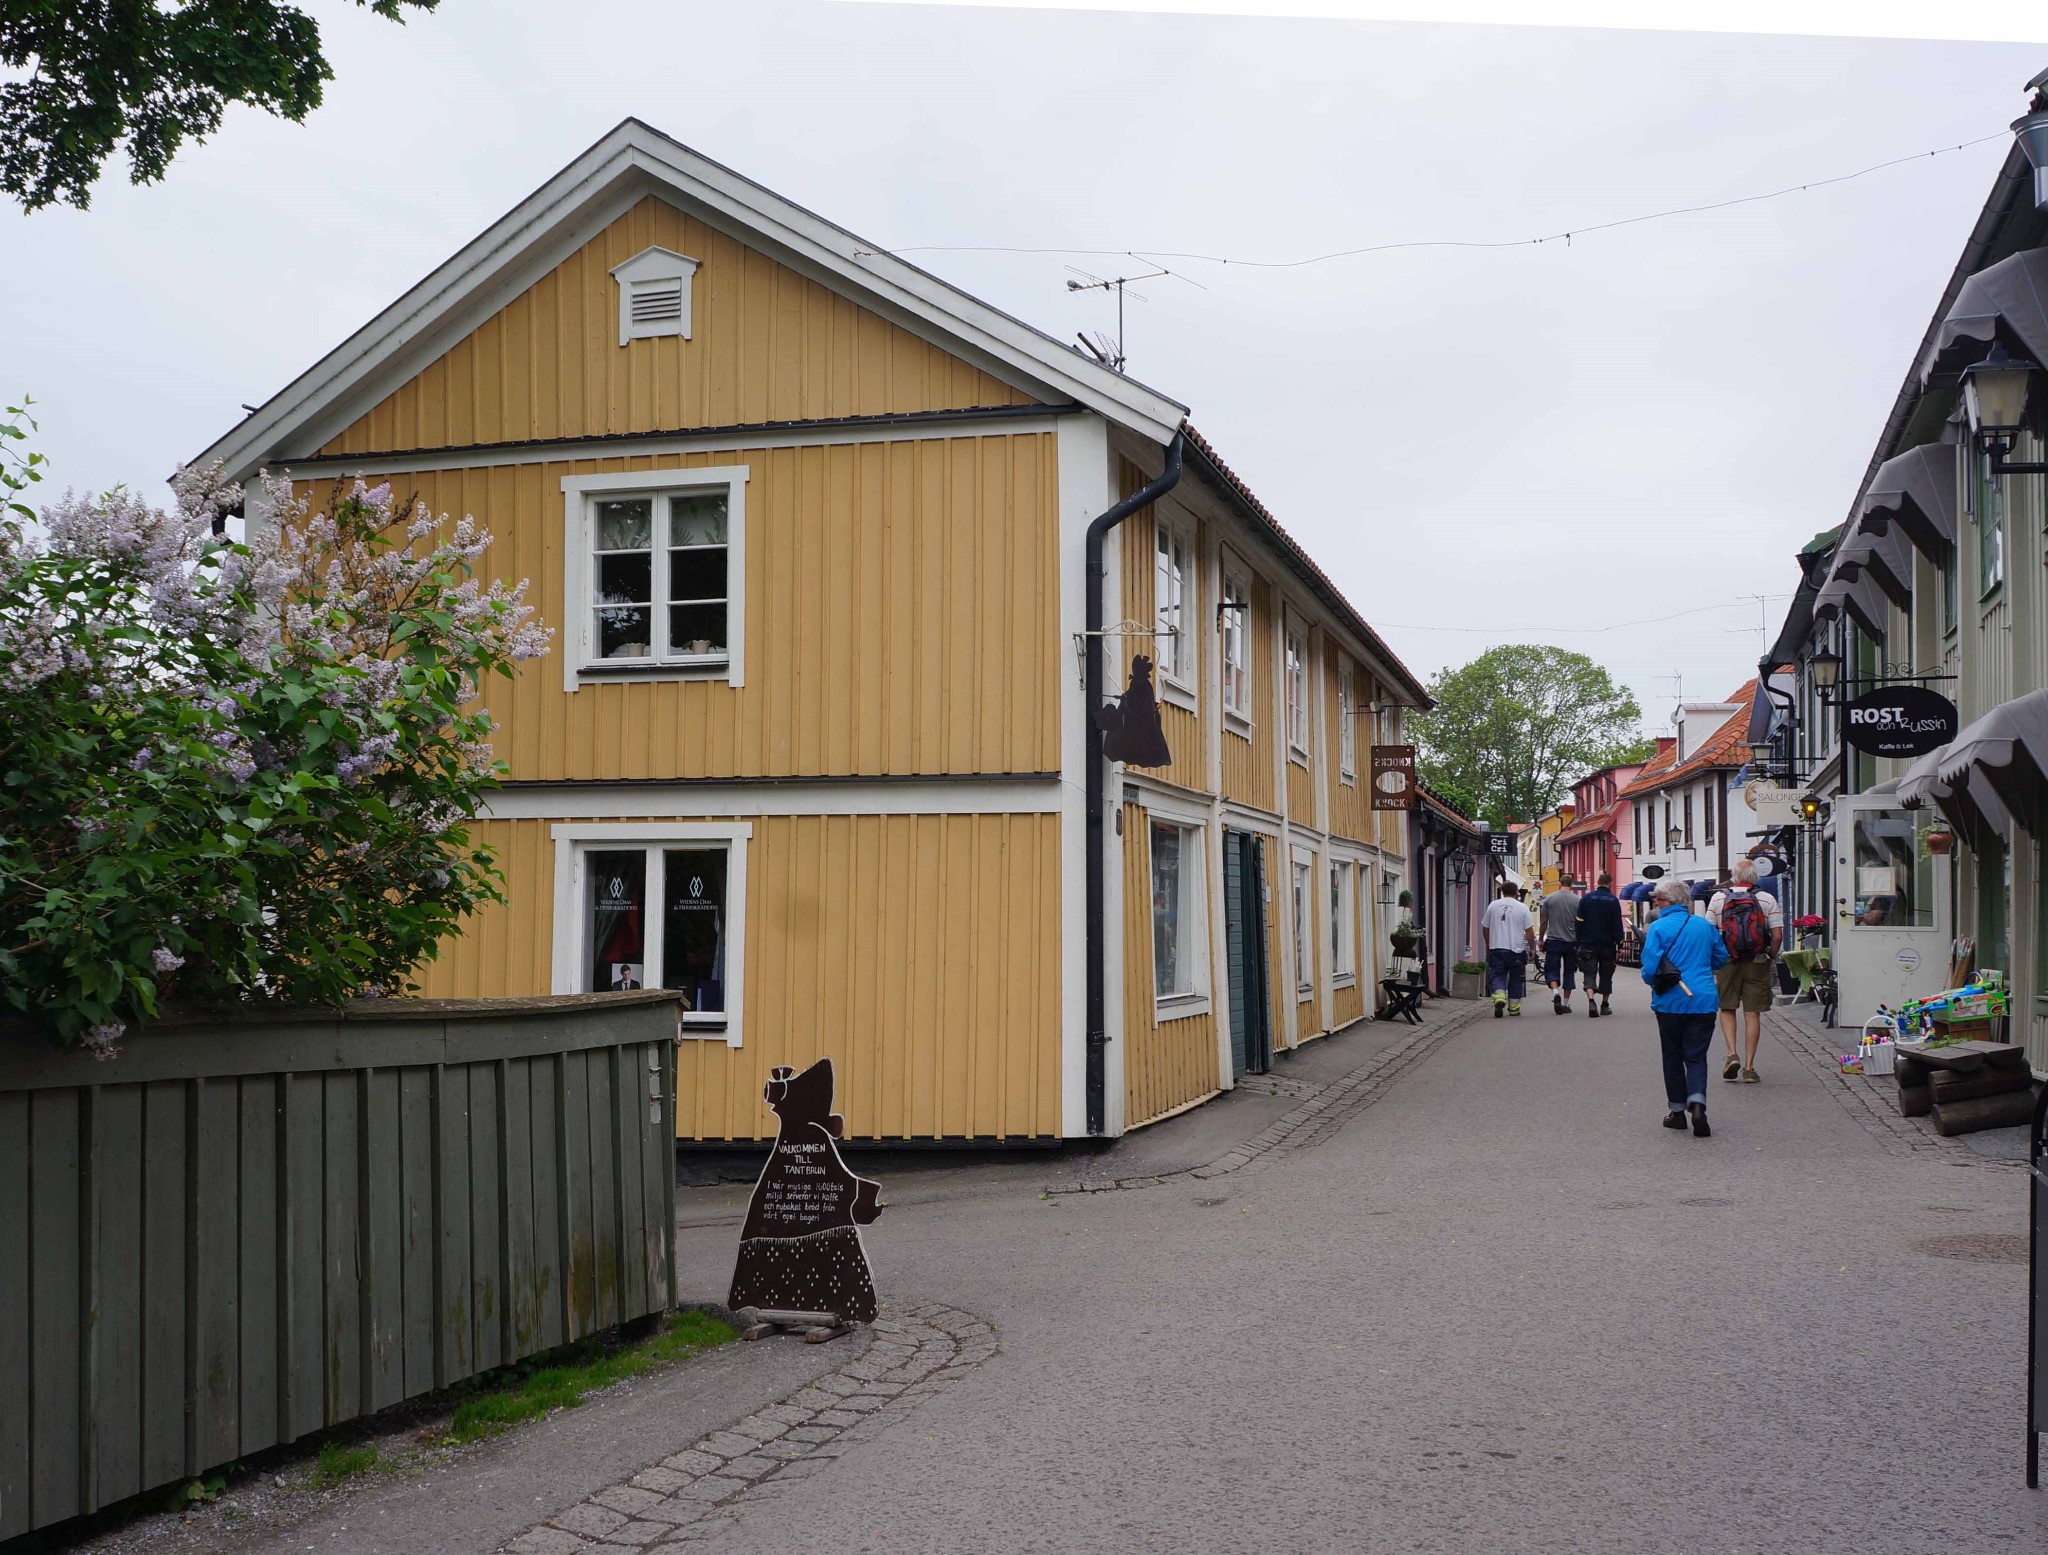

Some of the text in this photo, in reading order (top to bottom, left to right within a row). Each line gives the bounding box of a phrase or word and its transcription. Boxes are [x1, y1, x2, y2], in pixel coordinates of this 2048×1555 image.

[1850, 707, 1905, 724] ROST
[1876, 715, 1947, 733] och Russin
[1757, 792, 1807, 802] SALONGE
[1490, 838, 1508, 846] Cri
[1490, 845, 1508, 853] Cri
[794, 1154, 812, 1164] TILL
[784, 1165, 826, 1175] TANT BRUN
[787, 1182, 812, 1193] mysiga
[821, 1192, 839, 1202] kaffe
[763, 1202, 775, 1210] och
[782, 1212, 796, 1224] eget
[799, 1213, 820, 1225] bageri
